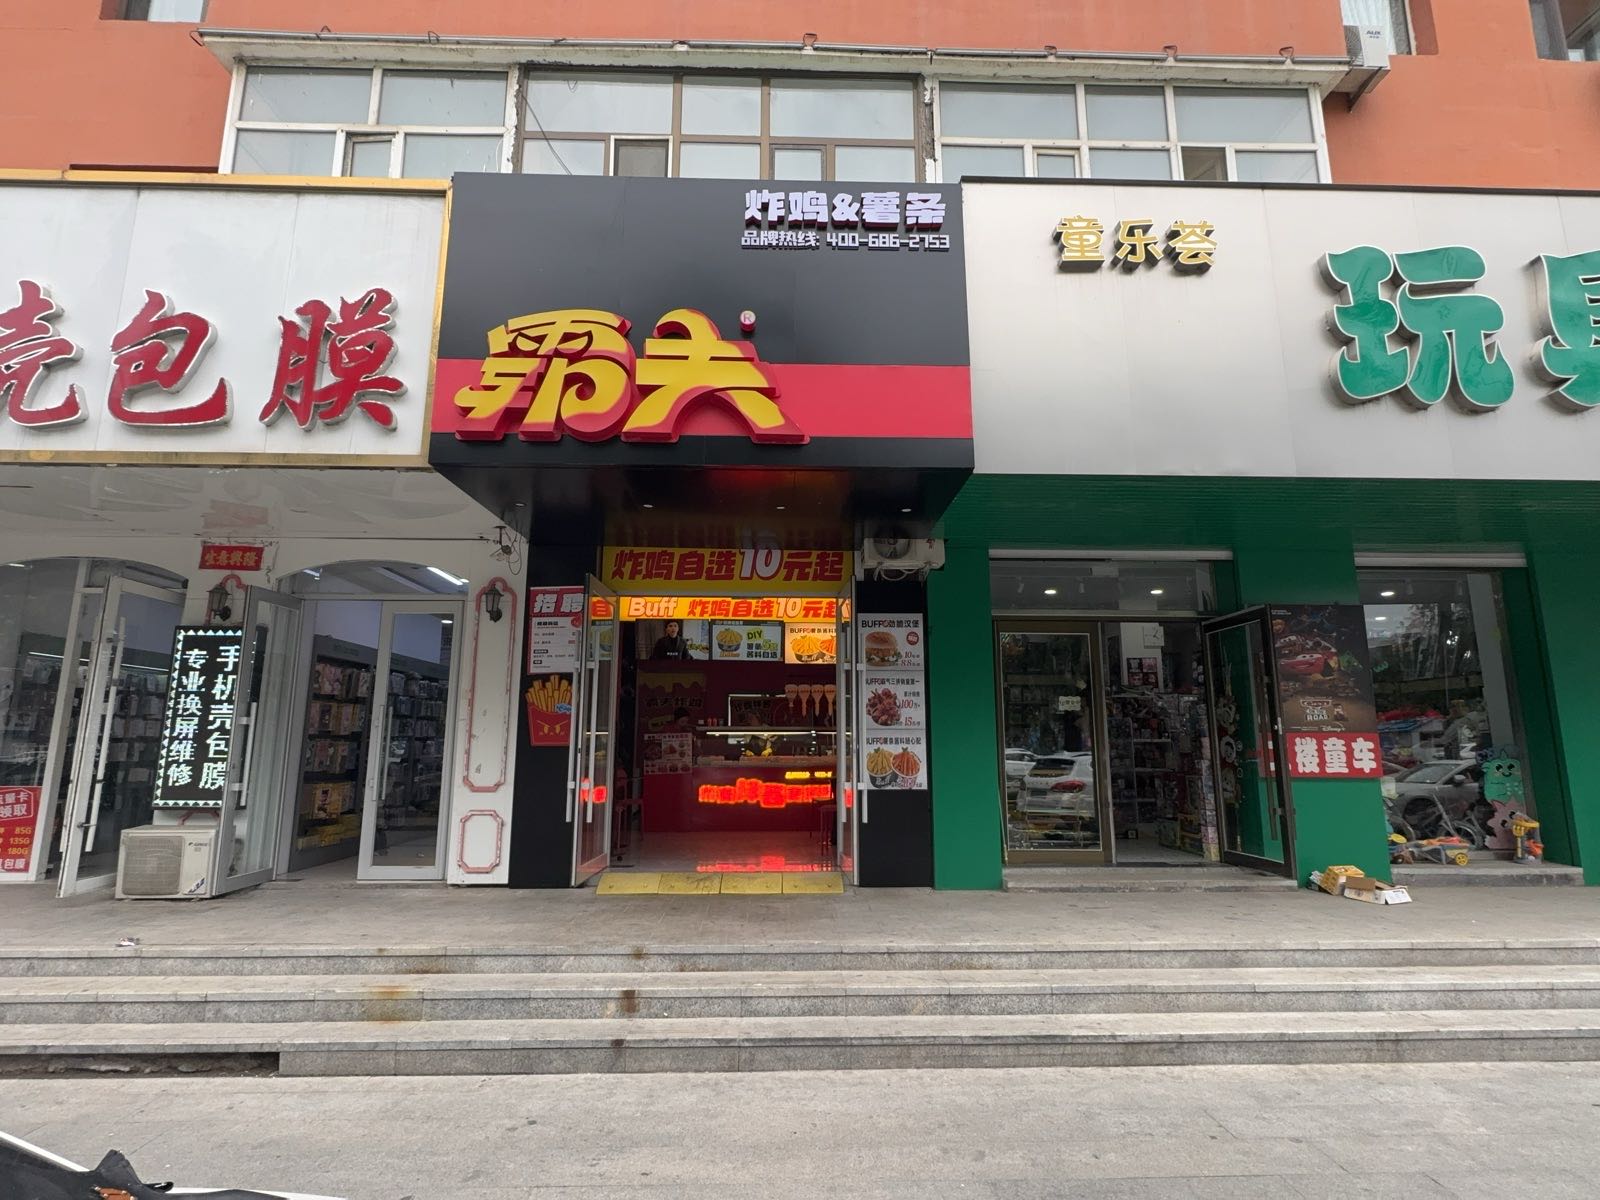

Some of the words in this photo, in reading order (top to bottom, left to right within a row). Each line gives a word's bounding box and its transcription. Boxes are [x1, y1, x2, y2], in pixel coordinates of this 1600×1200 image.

[744, 189, 947, 228] 炸鸡&薯条
[741, 230, 820, 248] 品牌热线:
[826, 232, 951, 250] 400-686-2753
[1053, 214, 1219, 270] 童乐荟
[0, 279, 410, 431] 壳包膜
[611, 544, 844, 582] 炸鸡自选10元起
[533, 593, 584, 614] 招聘
[628, 597, 678, 618] Buff
[747, 630, 763, 640] DIY
[167, 648, 208, 787] 专业换屏维修
[10, 837, 30, 845] 135G
